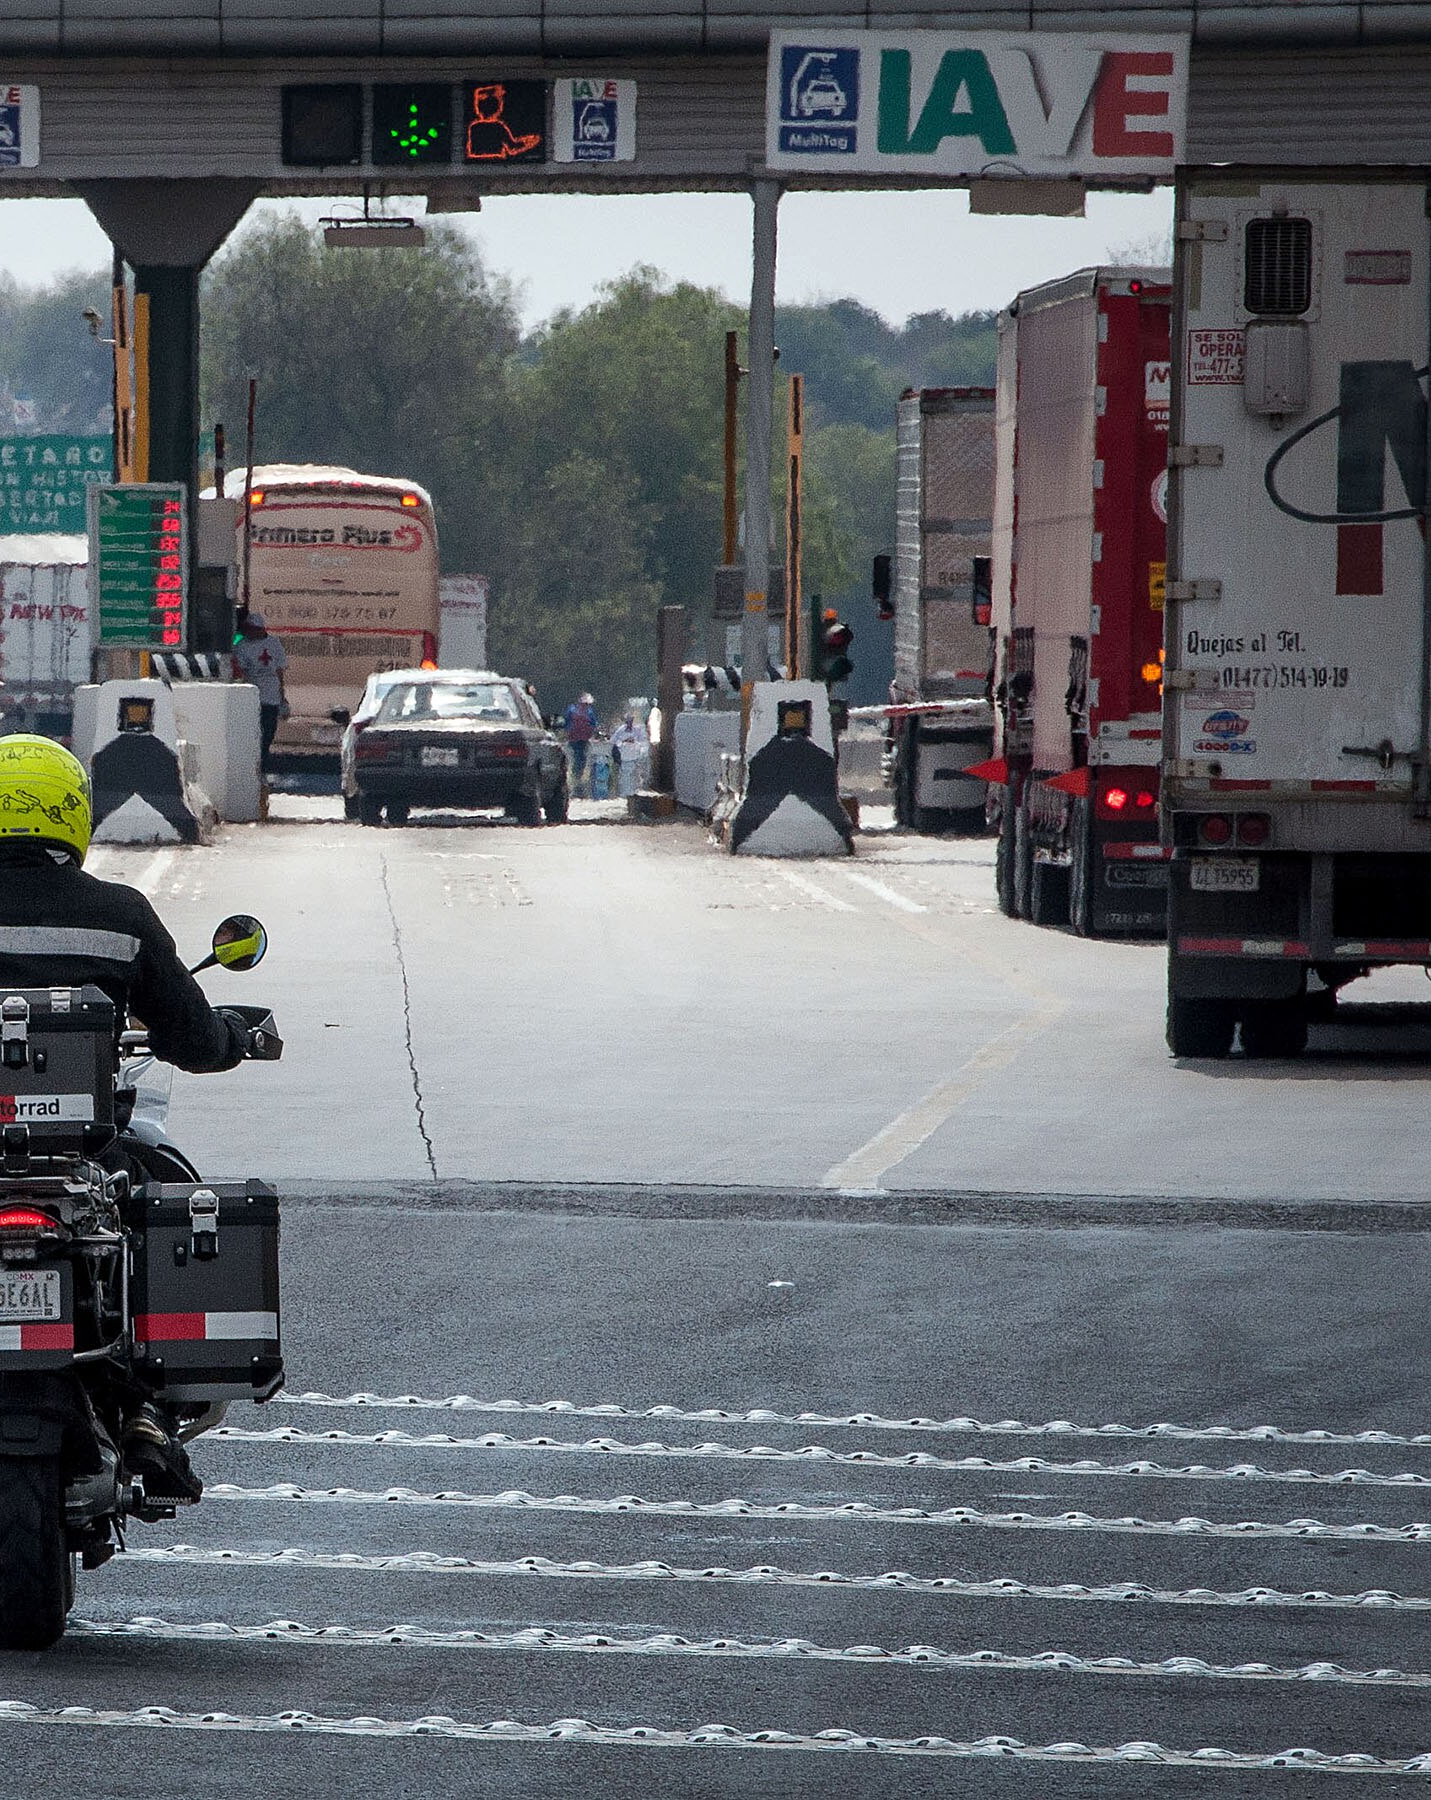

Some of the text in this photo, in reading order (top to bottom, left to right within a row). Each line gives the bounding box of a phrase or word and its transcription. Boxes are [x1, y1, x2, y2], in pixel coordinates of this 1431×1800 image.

[572, 79, 618, 98] IAVE
[877, 47, 1174, 157] IAVE
[788, 132, 849, 151] MultiTag
[1194, 333, 1244, 342] SE SOL
[1199, 343, 1246, 357] OPERA
[31, 470, 113, 487] HISTOR
[1187, 630, 1306, 657] Quejas al Tel.
